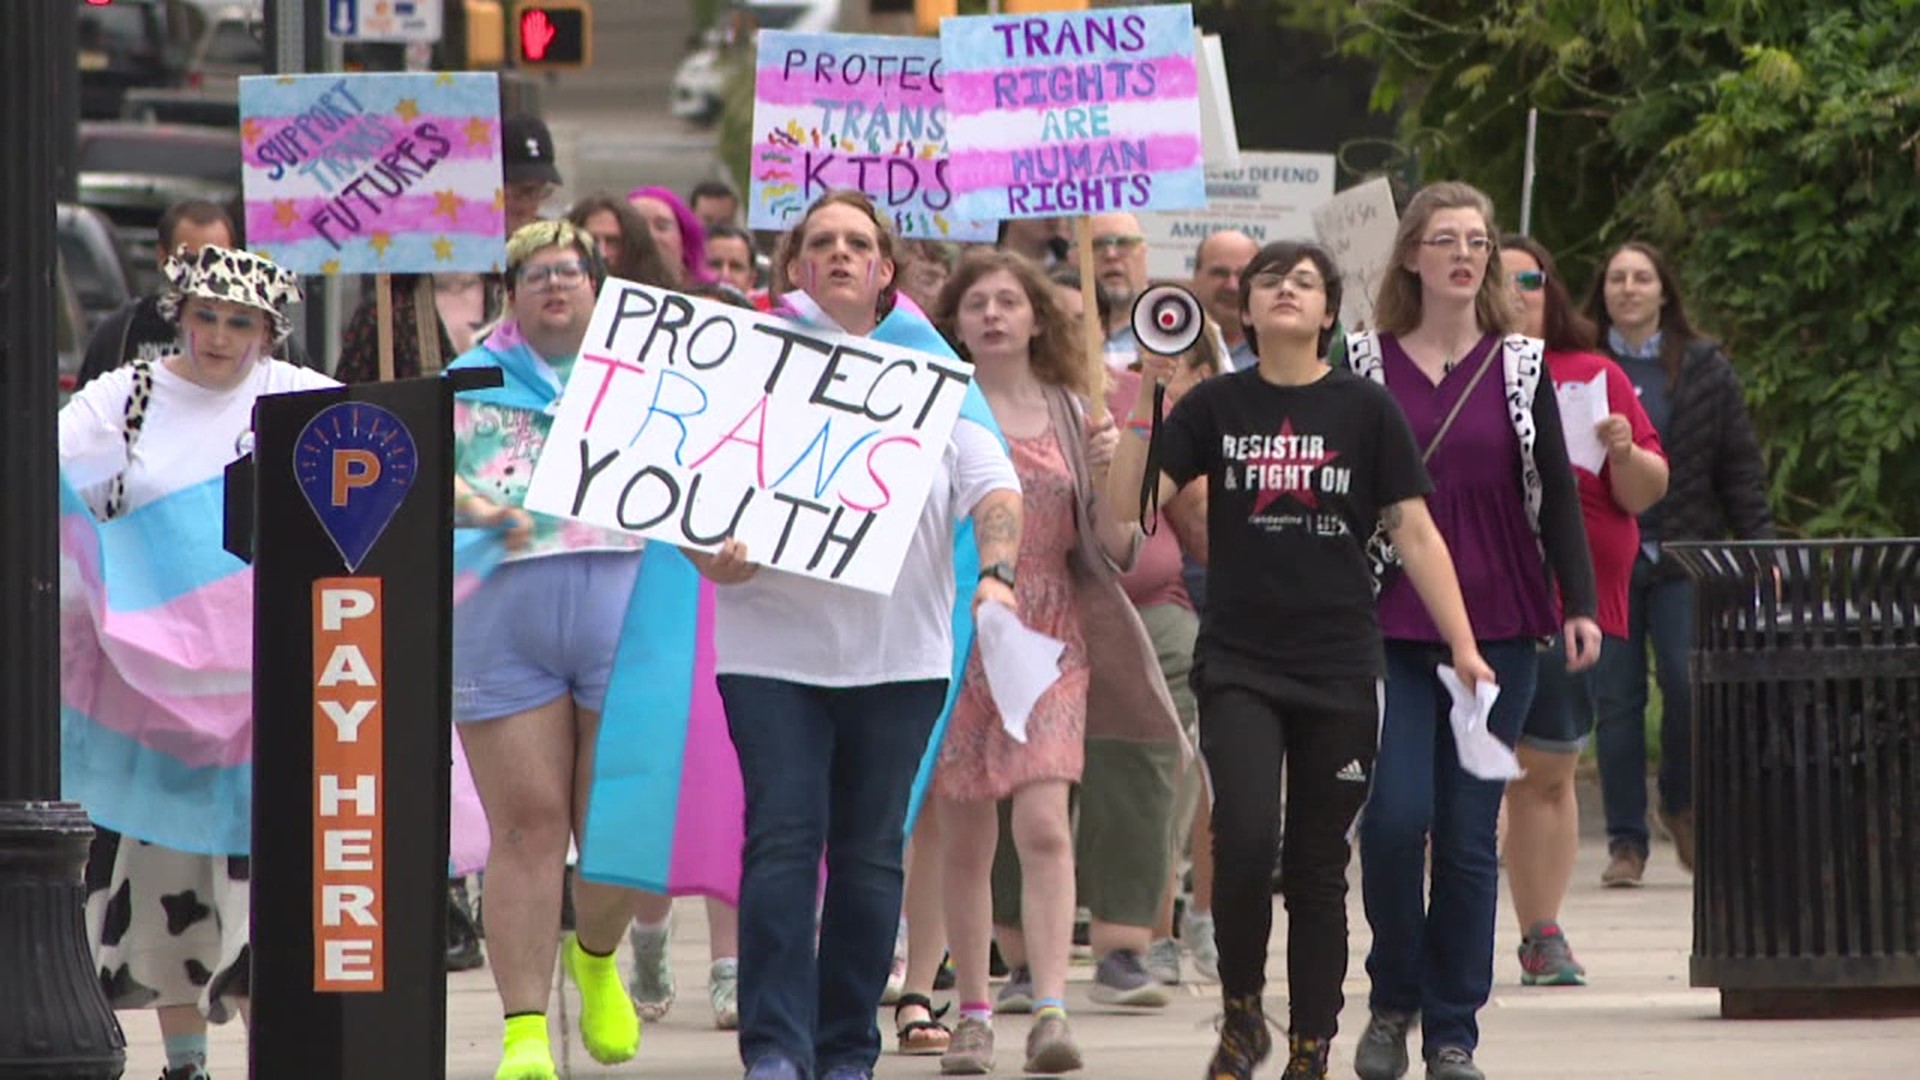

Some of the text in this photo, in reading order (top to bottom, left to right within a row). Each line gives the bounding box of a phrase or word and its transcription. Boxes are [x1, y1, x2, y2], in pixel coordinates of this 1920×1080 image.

[992, 15, 1146, 58] TRANS
[784, 48, 944, 94] PROTEC
[992, 62, 1157, 108] RIGHTS
[256, 79, 364, 181] SUPPORT
[812, 98, 947, 141] TRANS
[1041, 104, 1111, 141] ARE
[298, 111, 395, 193] TRANS
[1010, 140, 1149, 182] HUMAN
[1248, 166, 1320, 184] DEFEND
[308, 122, 451, 252] FUTURES
[804, 151, 951, 211] KIDS
[1006, 174, 1152, 215] RIGHTS
[605, 287, 971, 430] PROTECT
[583, 352, 922, 512] TRANS
[1222, 434, 1325, 460] RESISTIR
[331, 449, 381, 506] P
[1224, 464, 1351, 494] & FIGHT ON
[570, 439, 877, 579] YOUTH
[317, 589, 378, 981] PAY HERE
